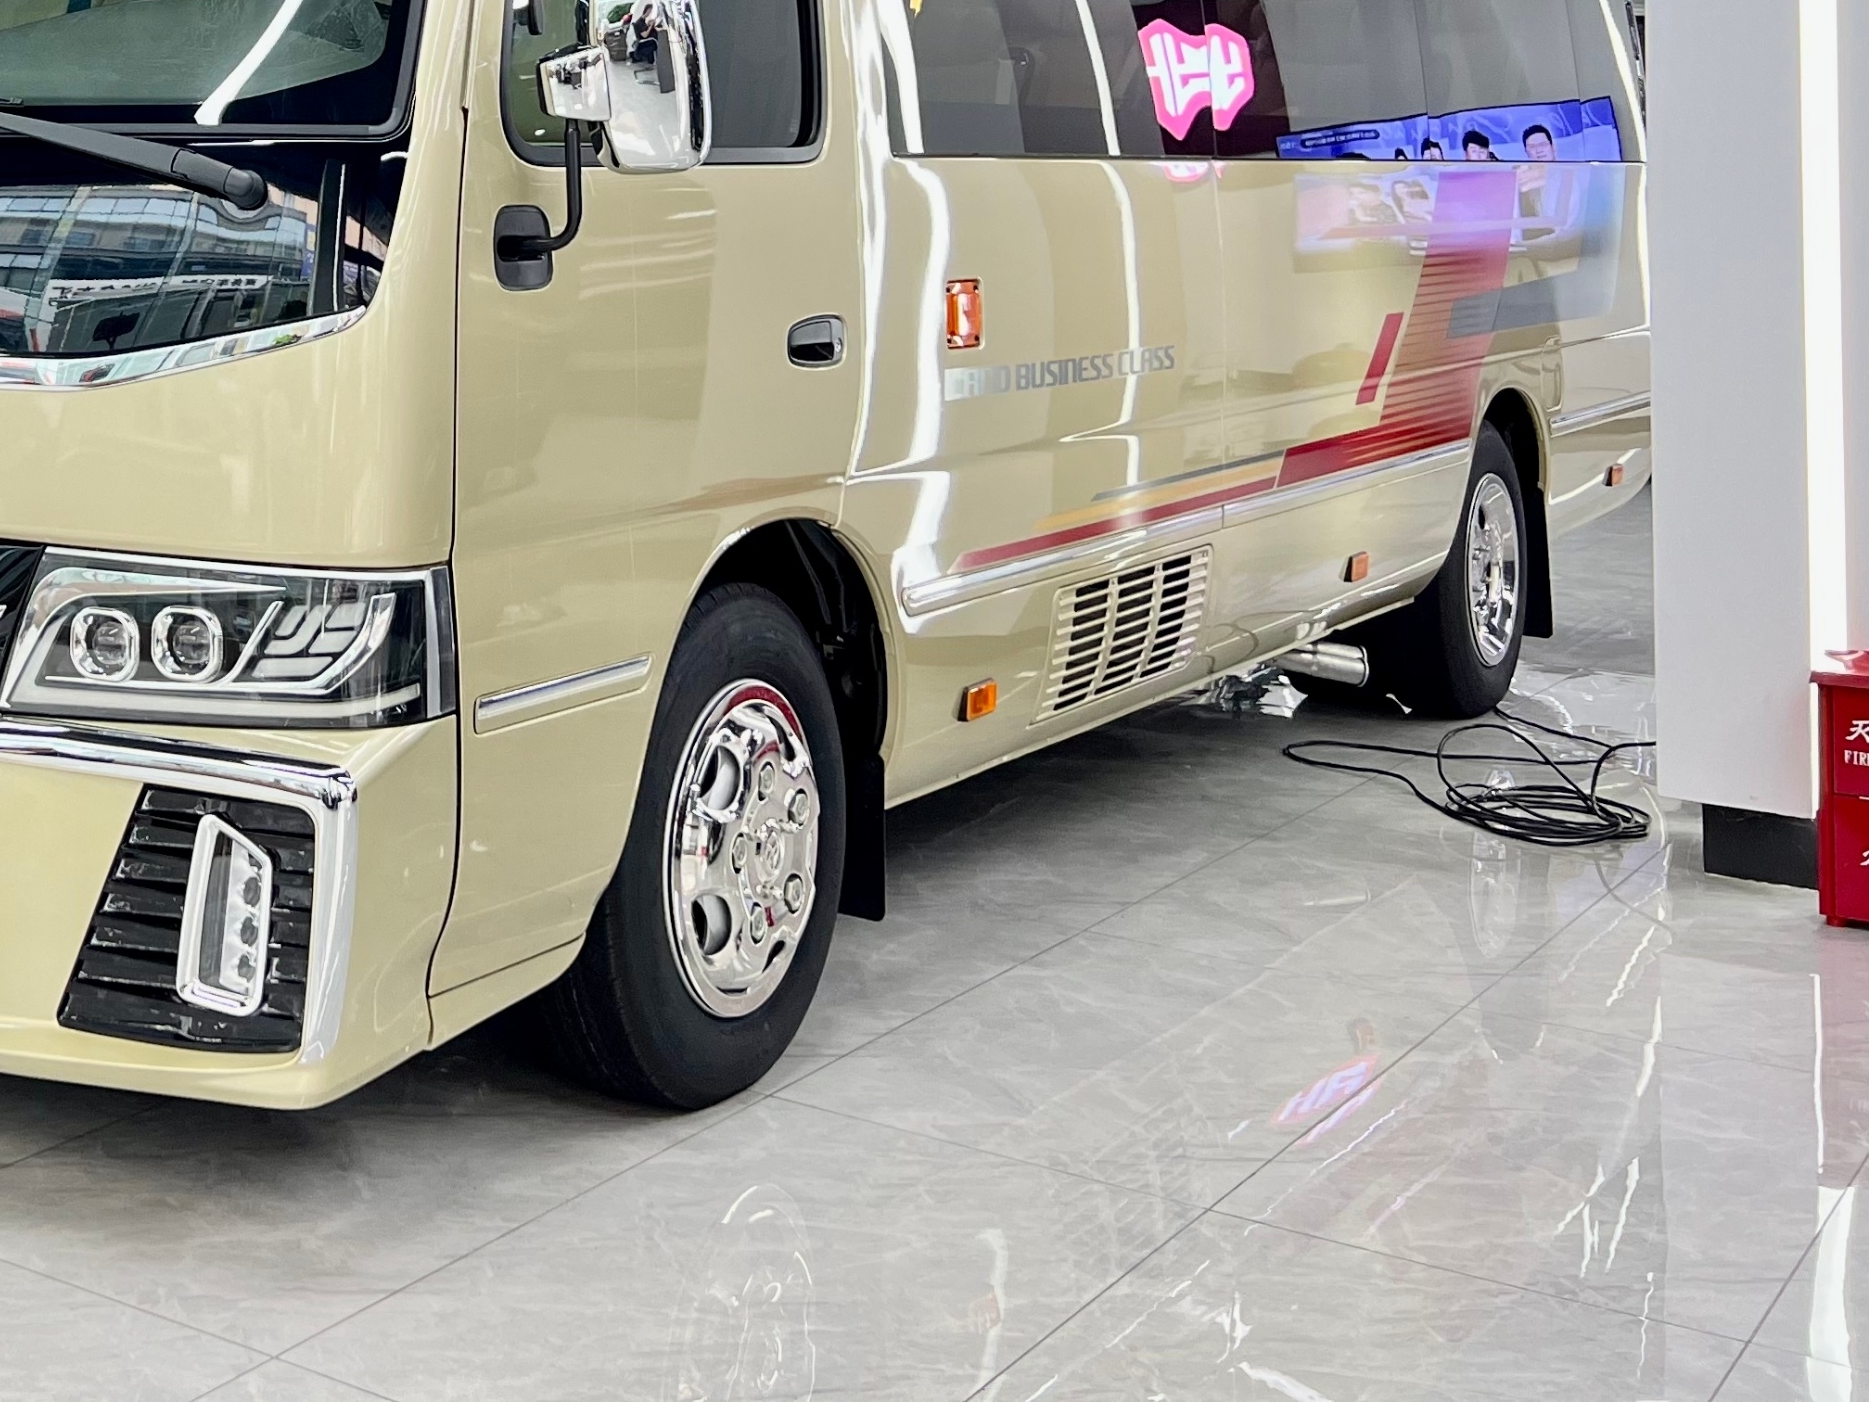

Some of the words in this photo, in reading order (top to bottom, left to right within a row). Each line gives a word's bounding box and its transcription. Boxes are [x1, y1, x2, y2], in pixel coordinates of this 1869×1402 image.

[1016, 353, 1114, 391] BUSINESS
[1118, 345, 1175, 376] CLASS
[1844, 749, 1869, 766] FIR
